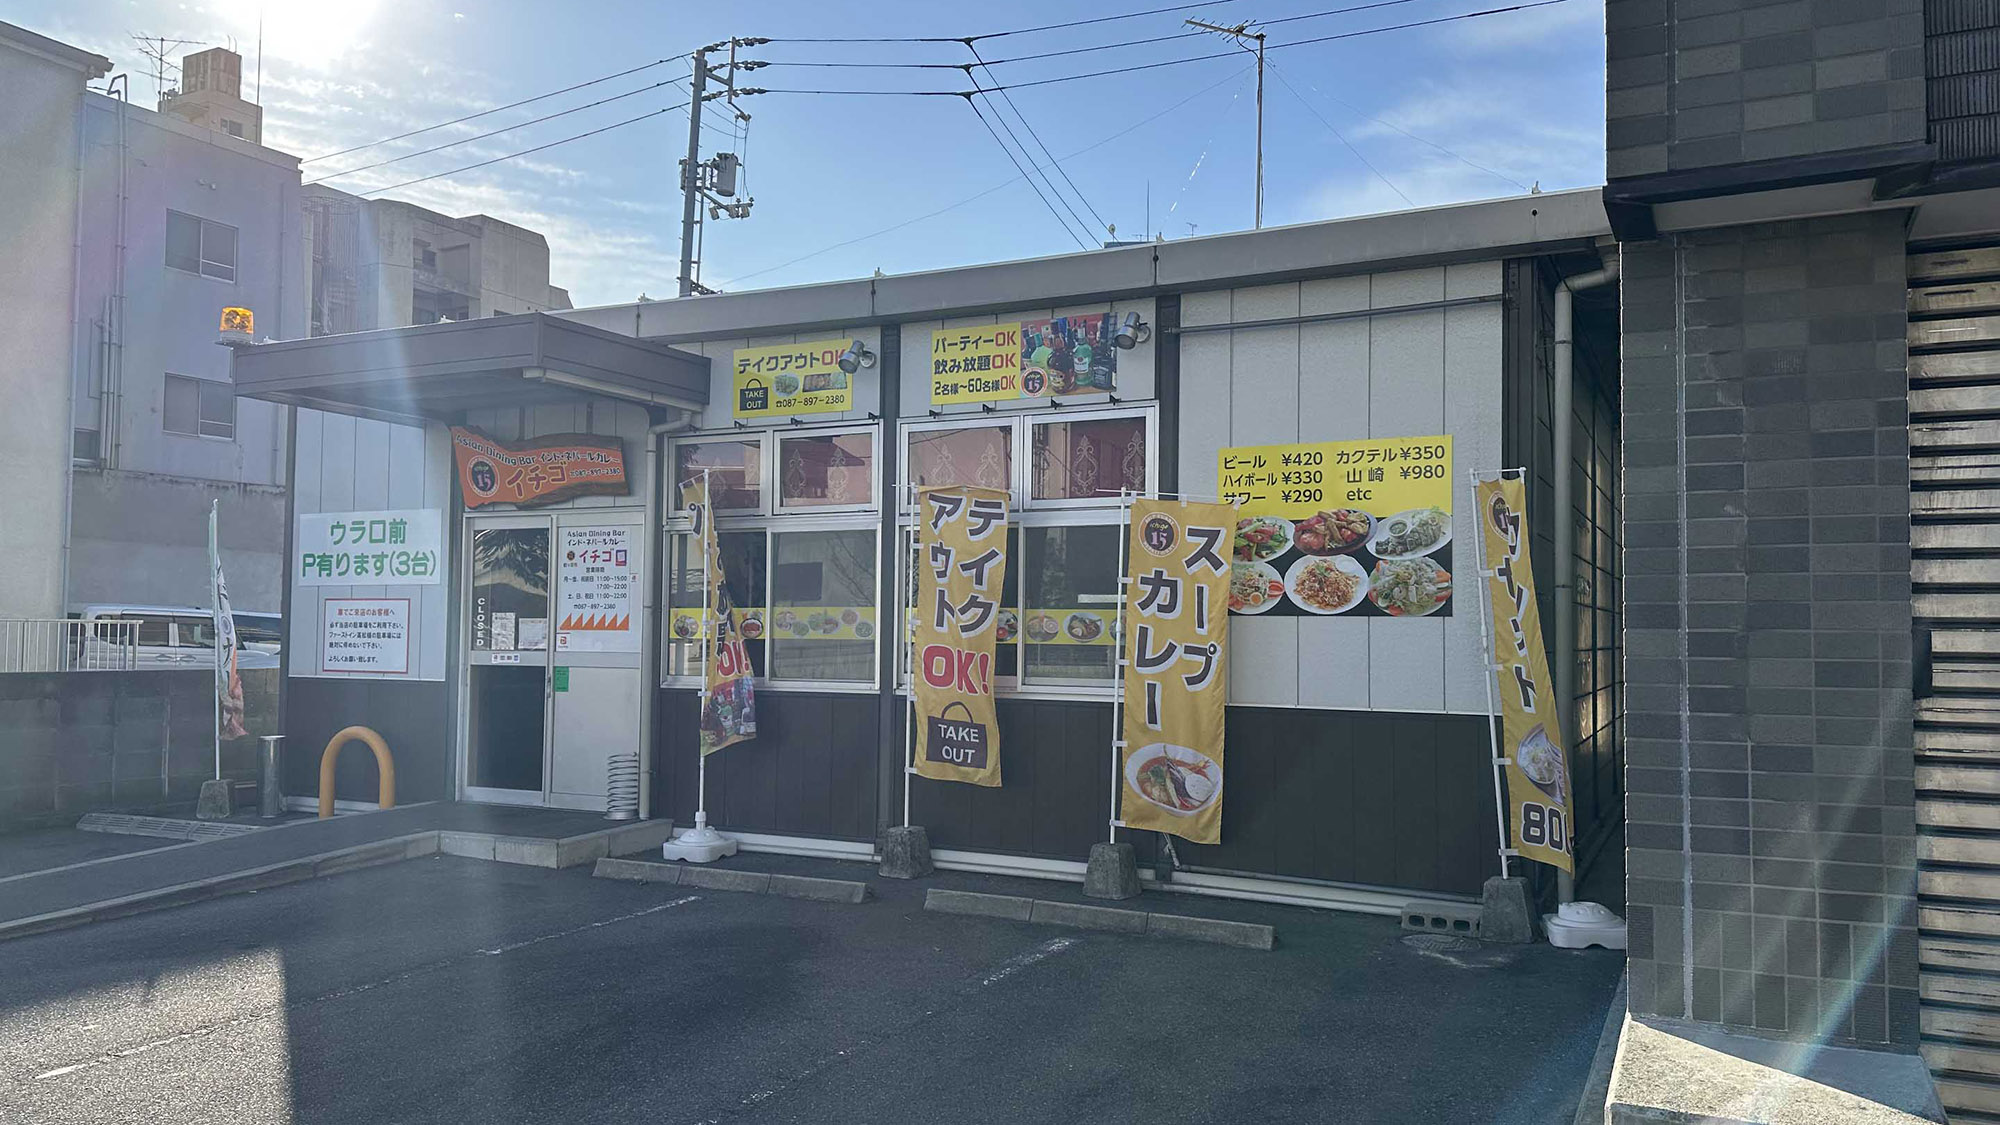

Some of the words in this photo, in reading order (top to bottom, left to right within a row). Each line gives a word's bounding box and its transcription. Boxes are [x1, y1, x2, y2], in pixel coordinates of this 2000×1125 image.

[934, 331, 1016, 354] パーティーOK
[934, 353, 1016, 375] 飲み放題OK
[744, 390, 764, 399] TAKE
[746, 401, 762, 409] OUT
[486, 445, 518, 466] Dining
[518, 456, 537, 466] Bar
[1224, 455, 1267, 470] ビール
[1281, 452, 1323, 467] ¥420
[1336, 448, 1398, 464] カクテル
[1400, 445, 1445, 460] ¥350
[507, 461, 566, 498] イチゴ
[1223, 472, 1278, 487] ハイボール
[1281, 470, 1323, 485] ¥330
[1400, 464, 1445, 479] ¥980
[1223, 492, 1267, 506] サワー
[1281, 488, 1323, 503] ¥290
[1346, 488, 1372, 501] etc
[330, 518, 408, 546] ウラ口前
[567, 530, 588, 538] Asian
[612, 529, 626, 537] Bar
[1151, 530, 1168, 550] 15
[302, 550, 437, 577] P有ります(3台)
[579, 548, 615, 564] イチゴ
[1183, 526, 1227, 691] スープ
[476, 597, 486, 646] CLOSED
[1134, 568, 1182, 731] カレー
[922, 644, 990, 695] OK!
[937, 723, 980, 743] TAKE
[941, 745, 976, 764] OUT
